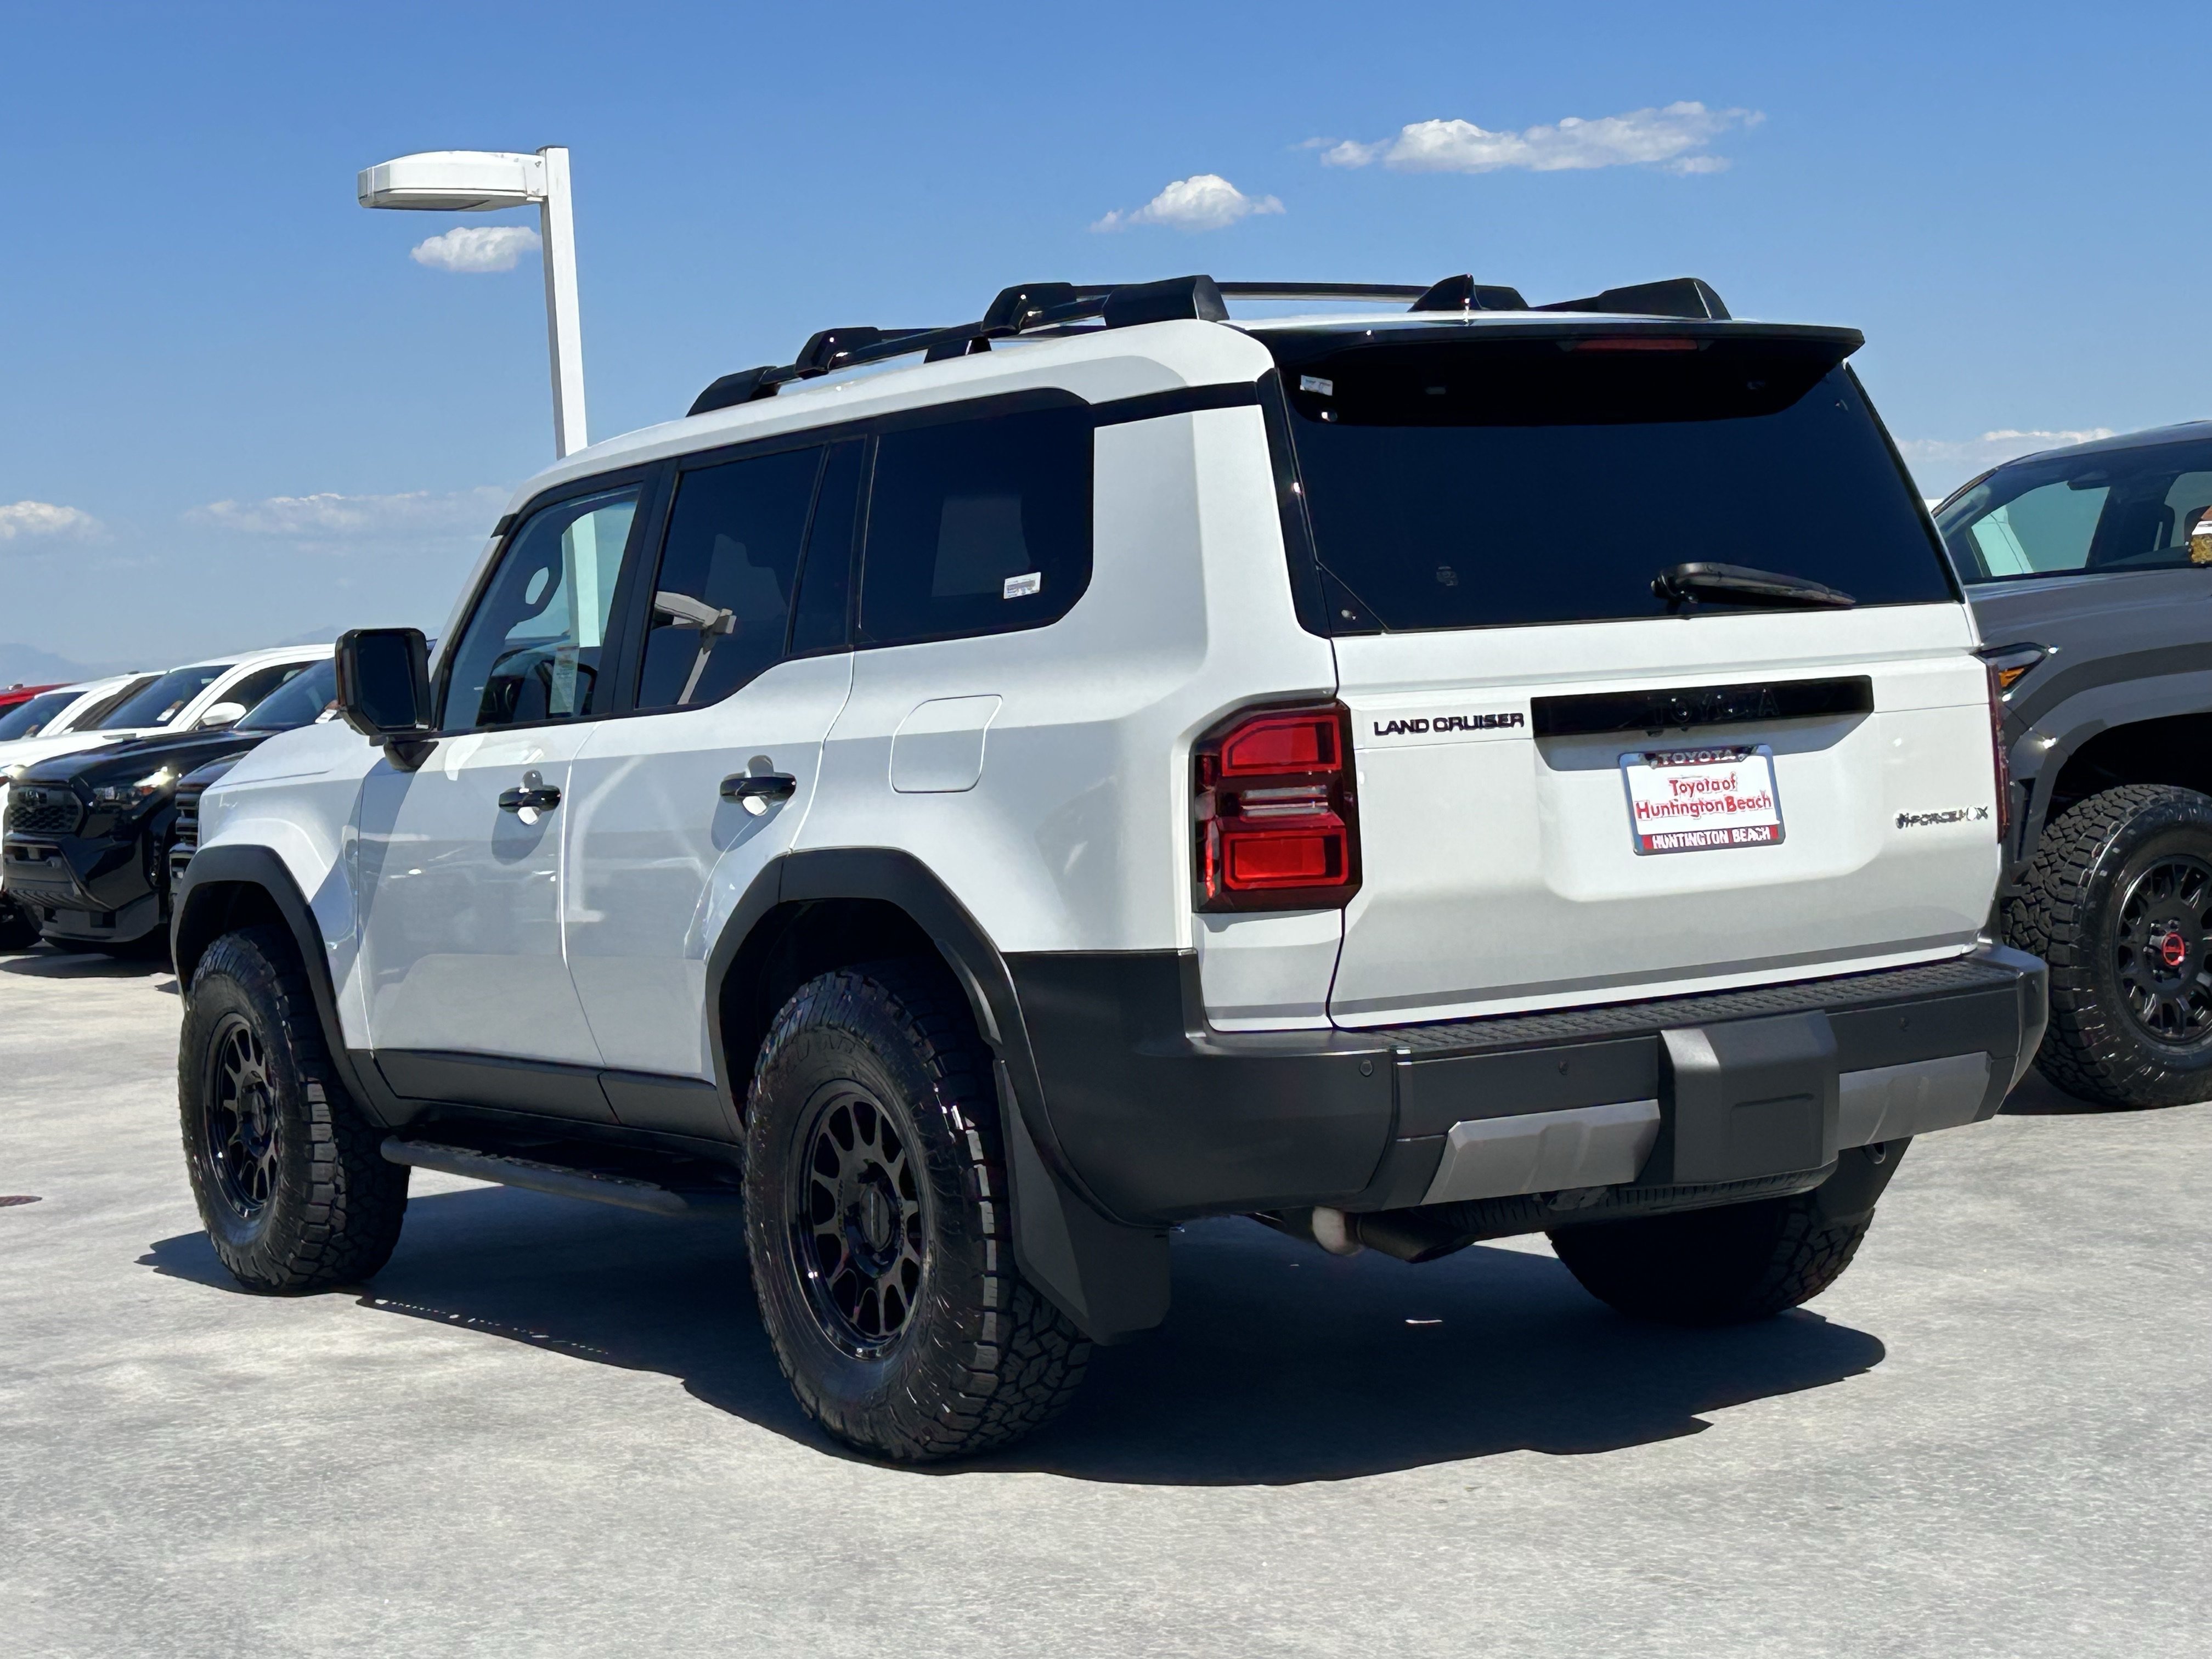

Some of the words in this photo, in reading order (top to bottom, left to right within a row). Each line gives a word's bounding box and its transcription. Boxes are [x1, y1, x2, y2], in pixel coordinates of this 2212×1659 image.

[1374, 719, 1429, 736] LAND
[1433, 713, 1525, 732] CRUISER
[1657, 750, 1736, 765] TOYOTA
[1669, 778, 1720, 798] Toyota
[1722, 772, 1737, 791] of
[1635, 799, 1724, 817] Huntington
[1724, 793, 1771, 813] Beach
[1652, 830, 1729, 849] HUNTINGTON
[1733, 826, 1771, 843] BEACH
